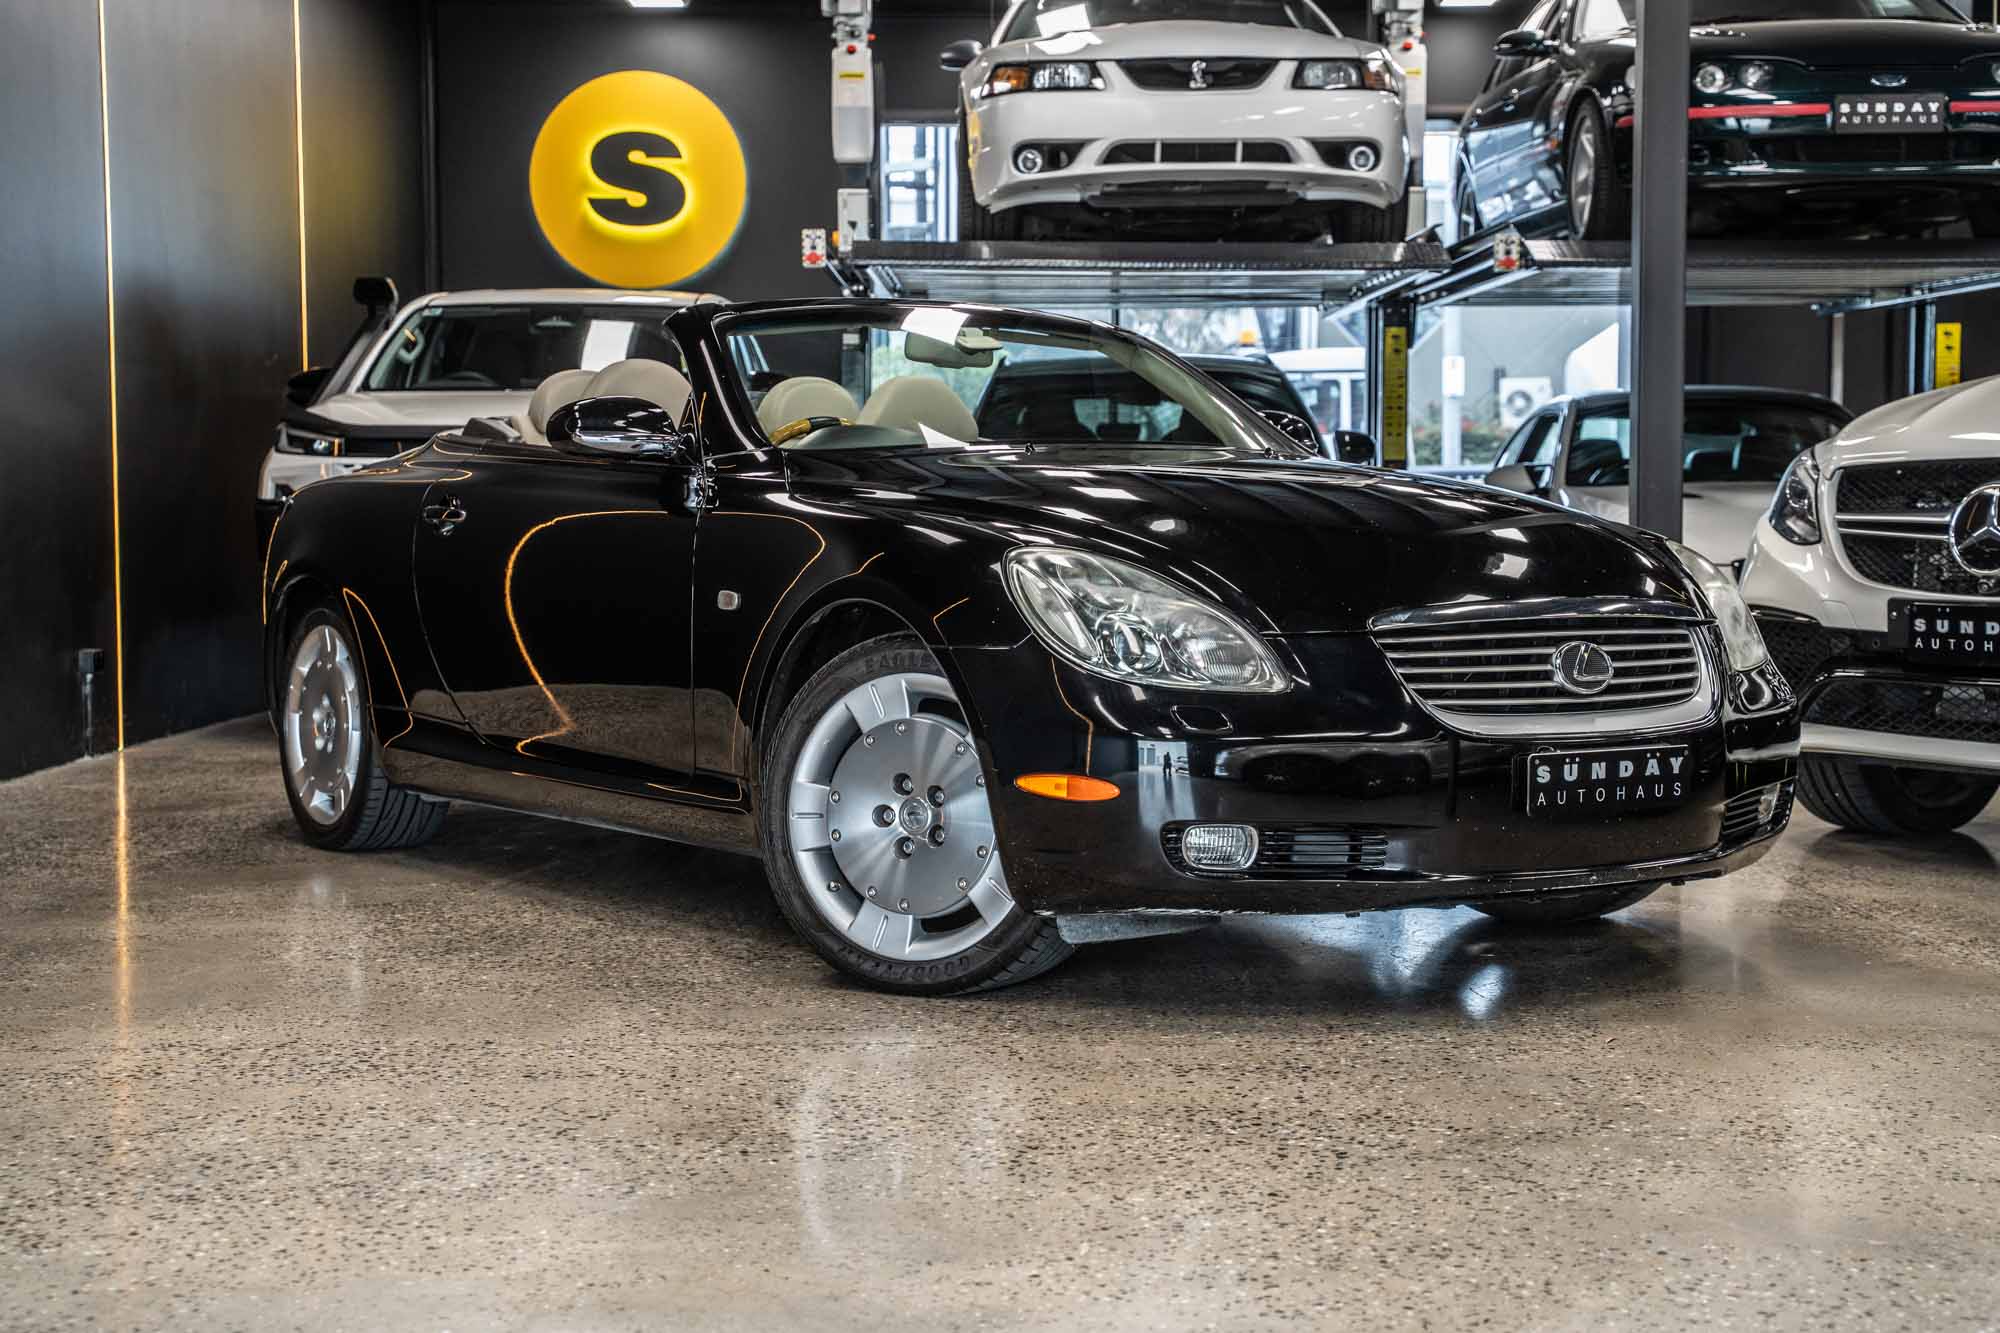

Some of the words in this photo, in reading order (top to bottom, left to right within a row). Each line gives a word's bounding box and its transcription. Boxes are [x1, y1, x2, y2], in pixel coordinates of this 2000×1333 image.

[1840, 102, 1940, 113] SUNDAY
[1840, 115, 1939, 124] AUTOHAUS
[587, 131, 686, 226] S
[1914, 638, 1993, 652] AUTOH
[1537, 782, 1681, 806] AUTOHAUS
